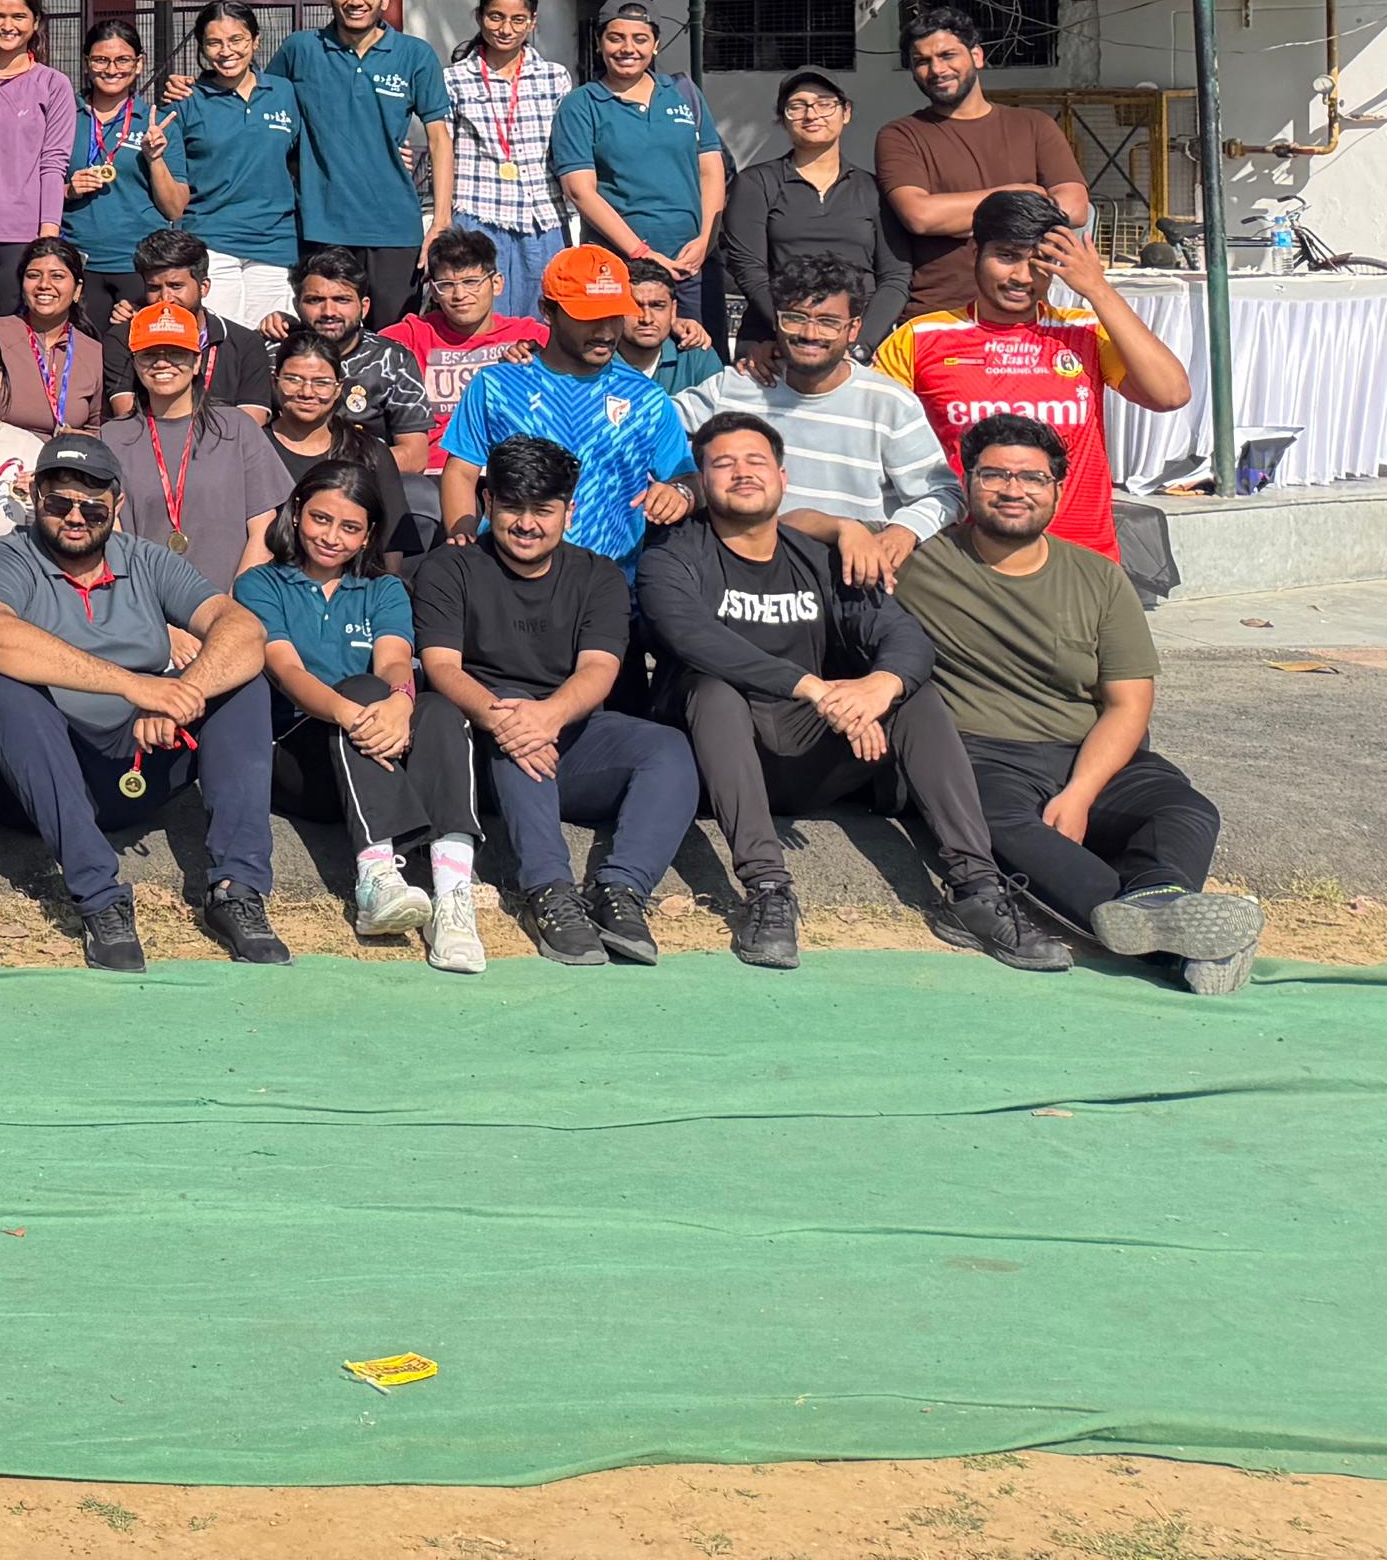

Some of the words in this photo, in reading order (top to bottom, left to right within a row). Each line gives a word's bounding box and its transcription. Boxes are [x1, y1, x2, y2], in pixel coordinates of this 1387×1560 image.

[984, 341, 1043, 355] Healthy
[1001, 354, 1040, 368] Tasty
[985, 367, 1032, 375] COOKING
[717, 589, 819, 623] ASTHETICS
